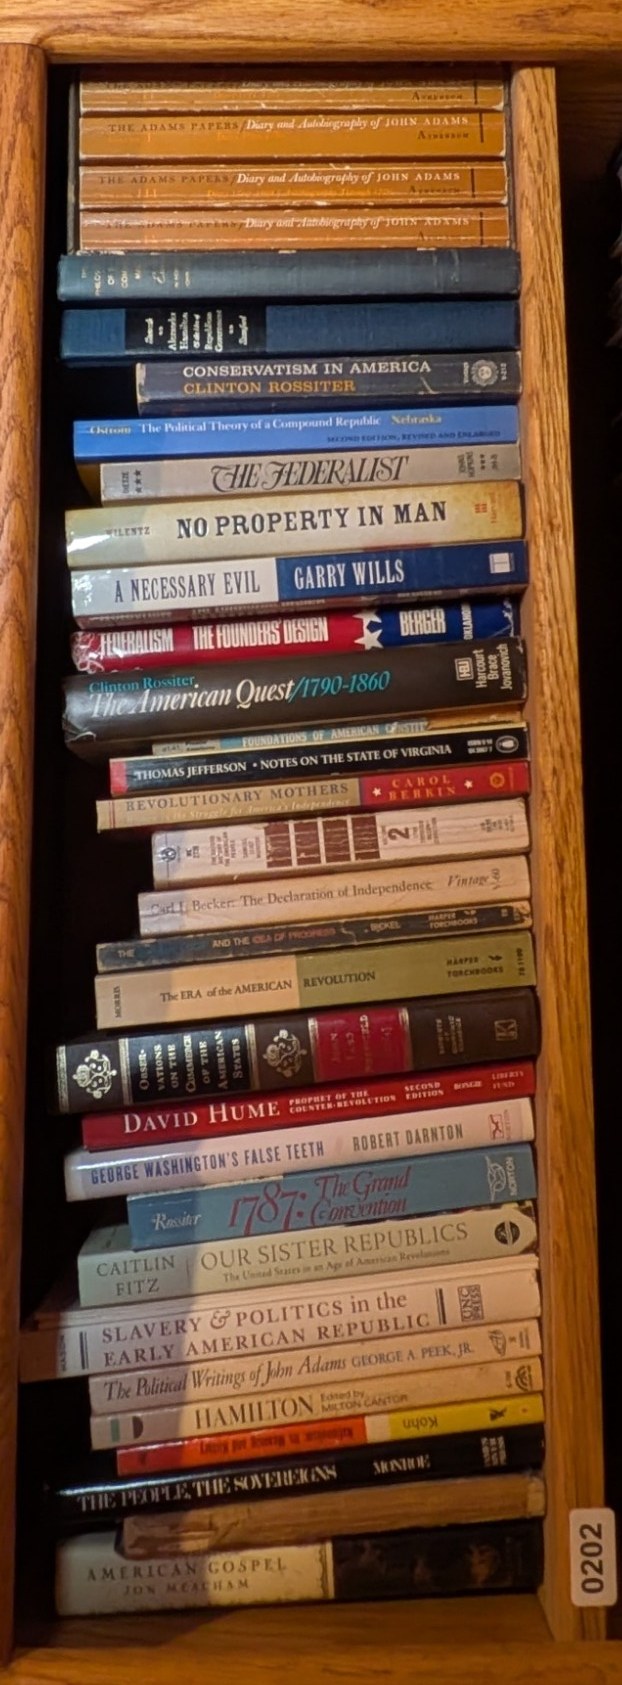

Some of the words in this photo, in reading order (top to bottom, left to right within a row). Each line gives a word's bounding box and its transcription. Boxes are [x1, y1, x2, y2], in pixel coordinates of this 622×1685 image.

[108, 124, 134, 132] THE
[141, 123, 185, 132] ADAMS
[277, 119, 294, 128] and
[298, 116, 367, 132] Autobiography
[385, 117, 417, 127] JOHN
[425, 117, 468, 125] ADAMS
[100, 176, 123, 184] THE
[131, 176, 175, 184] ADAMS
[268, 174, 285, 183] and
[289, 172, 358, 185] Autobiography
[377, 173, 409, 182] JOHN
[415, 173, 460, 181] ADAMS
[142, 220, 183, 229] ADAMS
[385, 218, 418, 226] JOHN
[425, 217, 469, 226] ADAMS
[183, 363, 317, 378] CONSERVATISM
[324, 363, 343, 374] IN
[350, 361, 431, 373] AMERICA
[183, 382, 261, 394] CLINTON
[268, 380, 356, 396] ROSSITER
[90, 426, 131, 434] Ostrom
[139, 424, 161, 433] The
[164, 421, 206, 432] Political
[208, 420, 248, 432] Theory
[251, 420, 262, 429] of
[272, 417, 333, 430] Compound
[336, 416, 381, 428] Republic
[392, 414, 442, 424] Nebraska
[402, 433, 436, 441] REVISED
[457, 430, 500, 438] ENLARGED
[211, 463, 262, 492] THE
[261, 455, 409, 491] FEDERALIST
[105, 527, 150, 538] WILENTZ
[177, 518, 207, 539] NO
[215, 507, 349, 537] PROPERTY
[358, 505, 383, 526] IN
[393, 501, 446, 524] MAN
[115, 580, 123, 602] A
[131, 573, 216, 601] NECESSARY
[224, 570, 260, 595] EVIL
[294, 563, 346, 590] GARRY
[352, 559, 405, 586] WILLS
[192, 625, 214, 650] THE
[216, 619, 281, 649] FOUNDERS'
[284, 617, 329, 644] DESIGN
[399, 608, 446, 637] BERGER
[473, 649, 487, 689] Harcourt
[89, 681, 139, 693] Clinton
[143, 675, 195, 689] Rossiter
[128, 684, 232, 714] American
[242, 730, 307, 748] FOUNDATIONS
[312, 729, 325, 741] OF
[331, 724, 379, 739] AMERICAN
[133, 769, 185, 780] THOMAS
[186, 762, 247, 778] JEFFERSON
[260, 758, 298, 770] NOTES
[300, 756, 318, 766] ON
[321, 753, 345, 764] THE
[346, 749, 381, 762] STATE
[383, 748, 398, 759] OF
[401, 744, 452, 758] VIRGINIA
[388, 787, 456, 801] BERKIN
[392, 775, 450, 788] CAROL
[127, 790, 262, 812] REVOLUTIONARY
[271, 783, 349, 799] MOTHERS
[388, 827, 410, 841] 2
[240, 895, 263, 907] The
[268, 888, 334, 905] Declaration
[338, 885, 348, 896] of
[353, 880, 432, 896] Independence
[448, 875, 490, 887] Vintage
[428, 913, 456, 921] HARPER
[118, 950, 135, 958] THE
[212, 940, 230, 948] AND
[233, 938, 250, 946] THE
[252, 935, 272, 944] IDEA
[447, 956, 479, 966] HARPER
[447, 966, 504, 978] TORCHBOOKS
[160, 992, 178, 1002] The
[180, 990, 202, 1000] ERA
[207, 987, 217, 997] of
[218, 986, 232, 995] the
[234, 979, 292, 994] AMERICAN
[303, 971, 375, 988] REVOLUTION
[168, 1044, 177, 1069] THE
[184, 1034, 196, 1093] COMMERCE
[199, 1040, 209, 1067] THE
[215, 1030, 228, 1090] AMERICAN
[232, 1038, 243, 1079] STATES
[154, 1044, 165, 1091] VATIONS
[170, 1071, 179, 1089] ON
[202, 1070, 211, 1084] OF
[492, 1070, 524, 1080] LIBERTY
[289, 1094, 331, 1106] PROPHET
[351, 1090, 369, 1098] THE
[404, 1082, 441, 1091] SECOND
[405, 1090, 444, 1100] EDITION
[124, 1111, 198, 1134] DAVID
[209, 1102, 281, 1124] HUME
[91, 1164, 139, 1184] GEORGE
[144, 1151, 238, 1178] WASHINGTON'S
[244, 1146, 281, 1165] FALSE
[286, 1141, 324, 1160] TEETH
[352, 1131, 400, 1151] ROBERT
[405, 1123, 464, 1145] DARNTON
[506, 1156, 517, 1196] NORTON
[153, 1211, 202, 1231] Rossiter
[228, 1181, 307, 1236] 1787:
[353, 1166, 412, 1198] Grand
[97, 1255, 175, 1277] CAITLIN
[201, 1248, 251, 1270] OUR
[258, 1238, 337, 1264] SISTER
[344, 1222, 468, 1253] REPUBLICS
[224, 1273, 239, 1282] The
[243, 1268, 272, 1279] United
[274, 1266, 300, 1276] States
[357, 1255, 399, 1266] American
[116, 1278, 160, 1296] FITZ
[461, 1286, 471, 1320] UNC
[102, 1318, 203, 1344] SLAVERY
[210, 1310, 231, 1329] &
[236, 1300, 343, 1327] POLITICS
[351, 1296, 369, 1313] in
[376, 1292, 408, 1311] the
[104, 1344, 174, 1367] EARLY
[186, 1328, 305, 1357] AMERICAN
[317, 1313, 430, 1341] REPUBLIC
[104, 1380, 131, 1400] The
[136, 1374, 188, 1397] Political
[191, 1369, 246, 1390] Writings
[249, 1361, 263, 1386] of
[261, 1360, 293, 1386] John
[297, 1355, 346, 1375] Adams
[351, 1351, 402, 1368] GEORGE
[195, 1394, 313, 1430] HAMILTON
[320, 1392, 352, 1400] Edited
[403, 1416, 438, 1430] Kohn
[77, 1493, 118, 1512] THE
[192, 1478, 231, 1498] THE
[234, 1464, 338, 1490] SOVEREIGNS
[372, 1454, 431, 1476] MONROE
[87, 1561, 197, 1582] AMERICAN
[208, 1557, 287, 1574] GOSPEL
[579, 1523, 604, 1594] 0202
[123, 1585, 155, 1597] JON
[167, 1578, 249, 1593] MEACHAM
